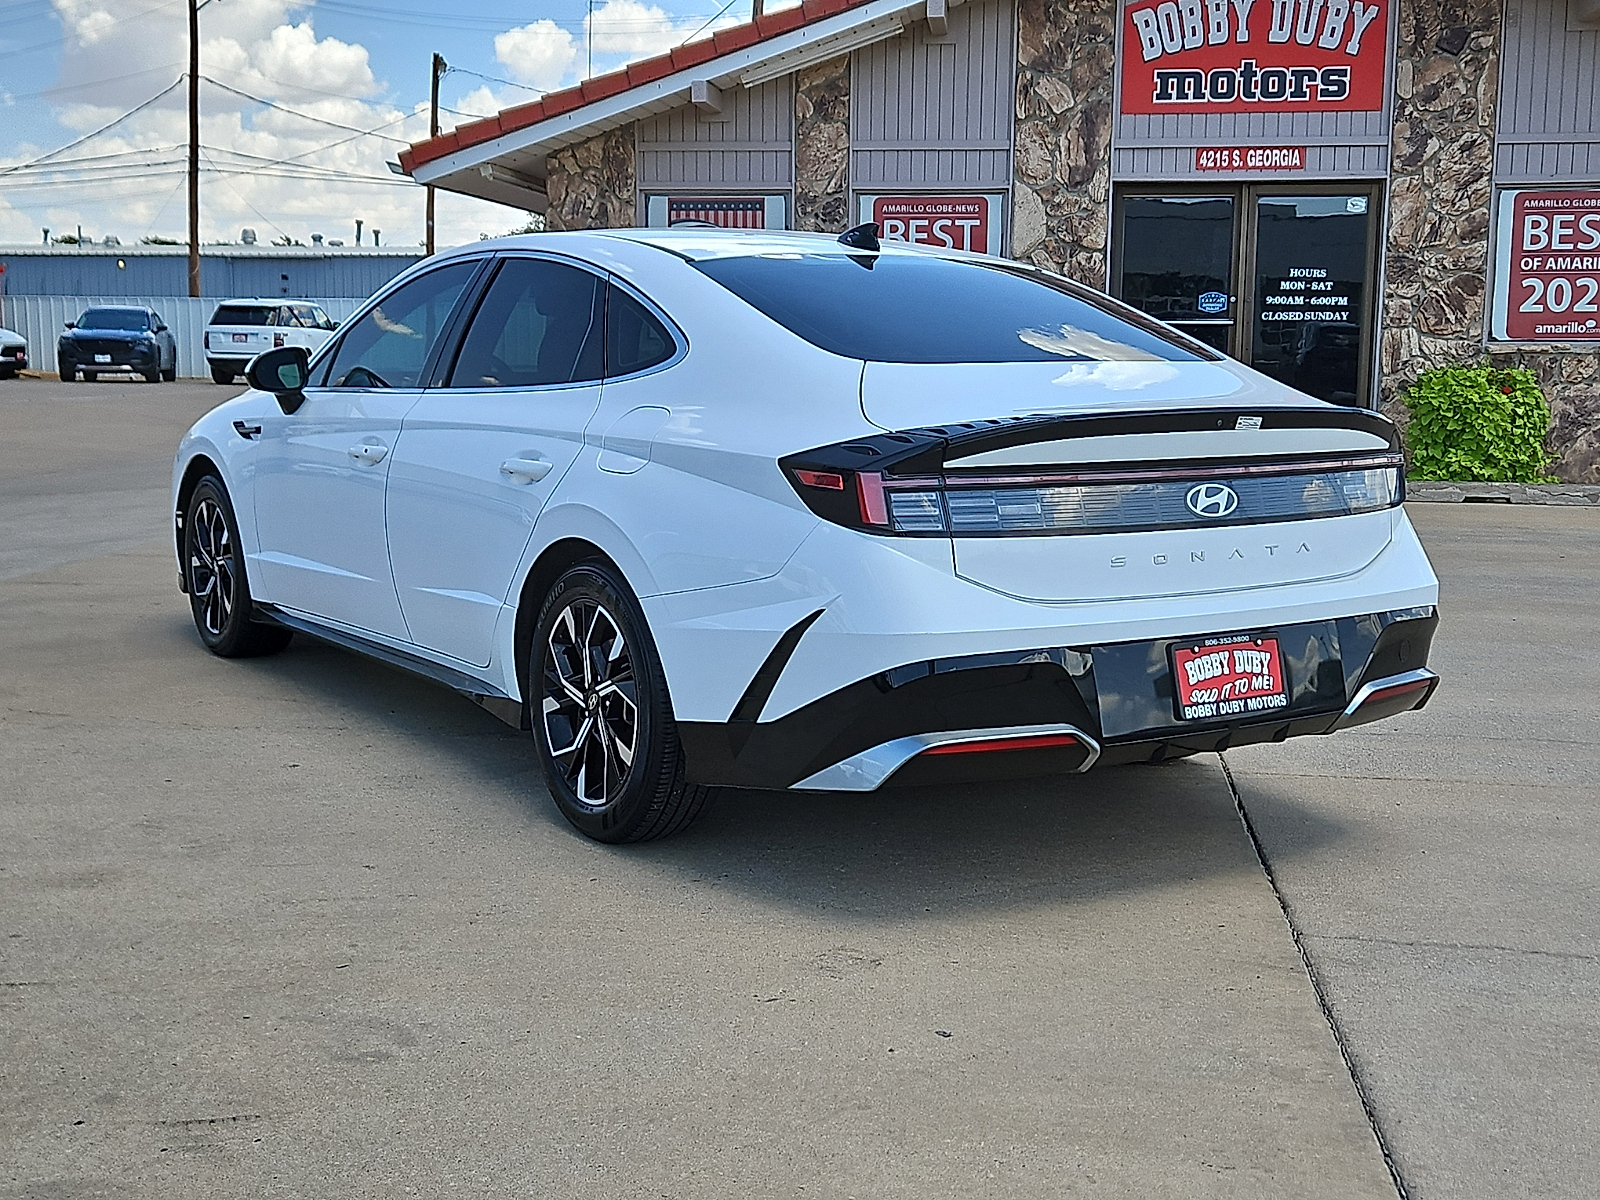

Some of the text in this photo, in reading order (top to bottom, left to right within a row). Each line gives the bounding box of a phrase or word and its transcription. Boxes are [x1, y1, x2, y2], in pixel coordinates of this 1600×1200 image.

[1132, 0, 1380, 62] BOBBY DUBY
[1152, 59, 1351, 103] motors
[1200, 148, 1301, 167] 4215 S. GEORGIA
[882, 204, 980, 213] AMARILLO GLOBE-NEWS
[1523, 199, 1571, 208] AMARILLO
[883, 218, 981, 253] BEST
[1289, 268, 1327, 278] HOURS
[1520, 257, 1543, 270] OF
[1519, 277, 1599, 312] 202
[1261, 311, 1350, 321] CLOSED SUNDAY
[1109, 541, 1312, 569] SONATA
[1184, 649, 1271, 686] BOBBY DUBY
[1189, 674, 1274, 704] SOLD IT TO ME!
[1184, 693, 1288, 719] BOBBY DUBY MOTORS
